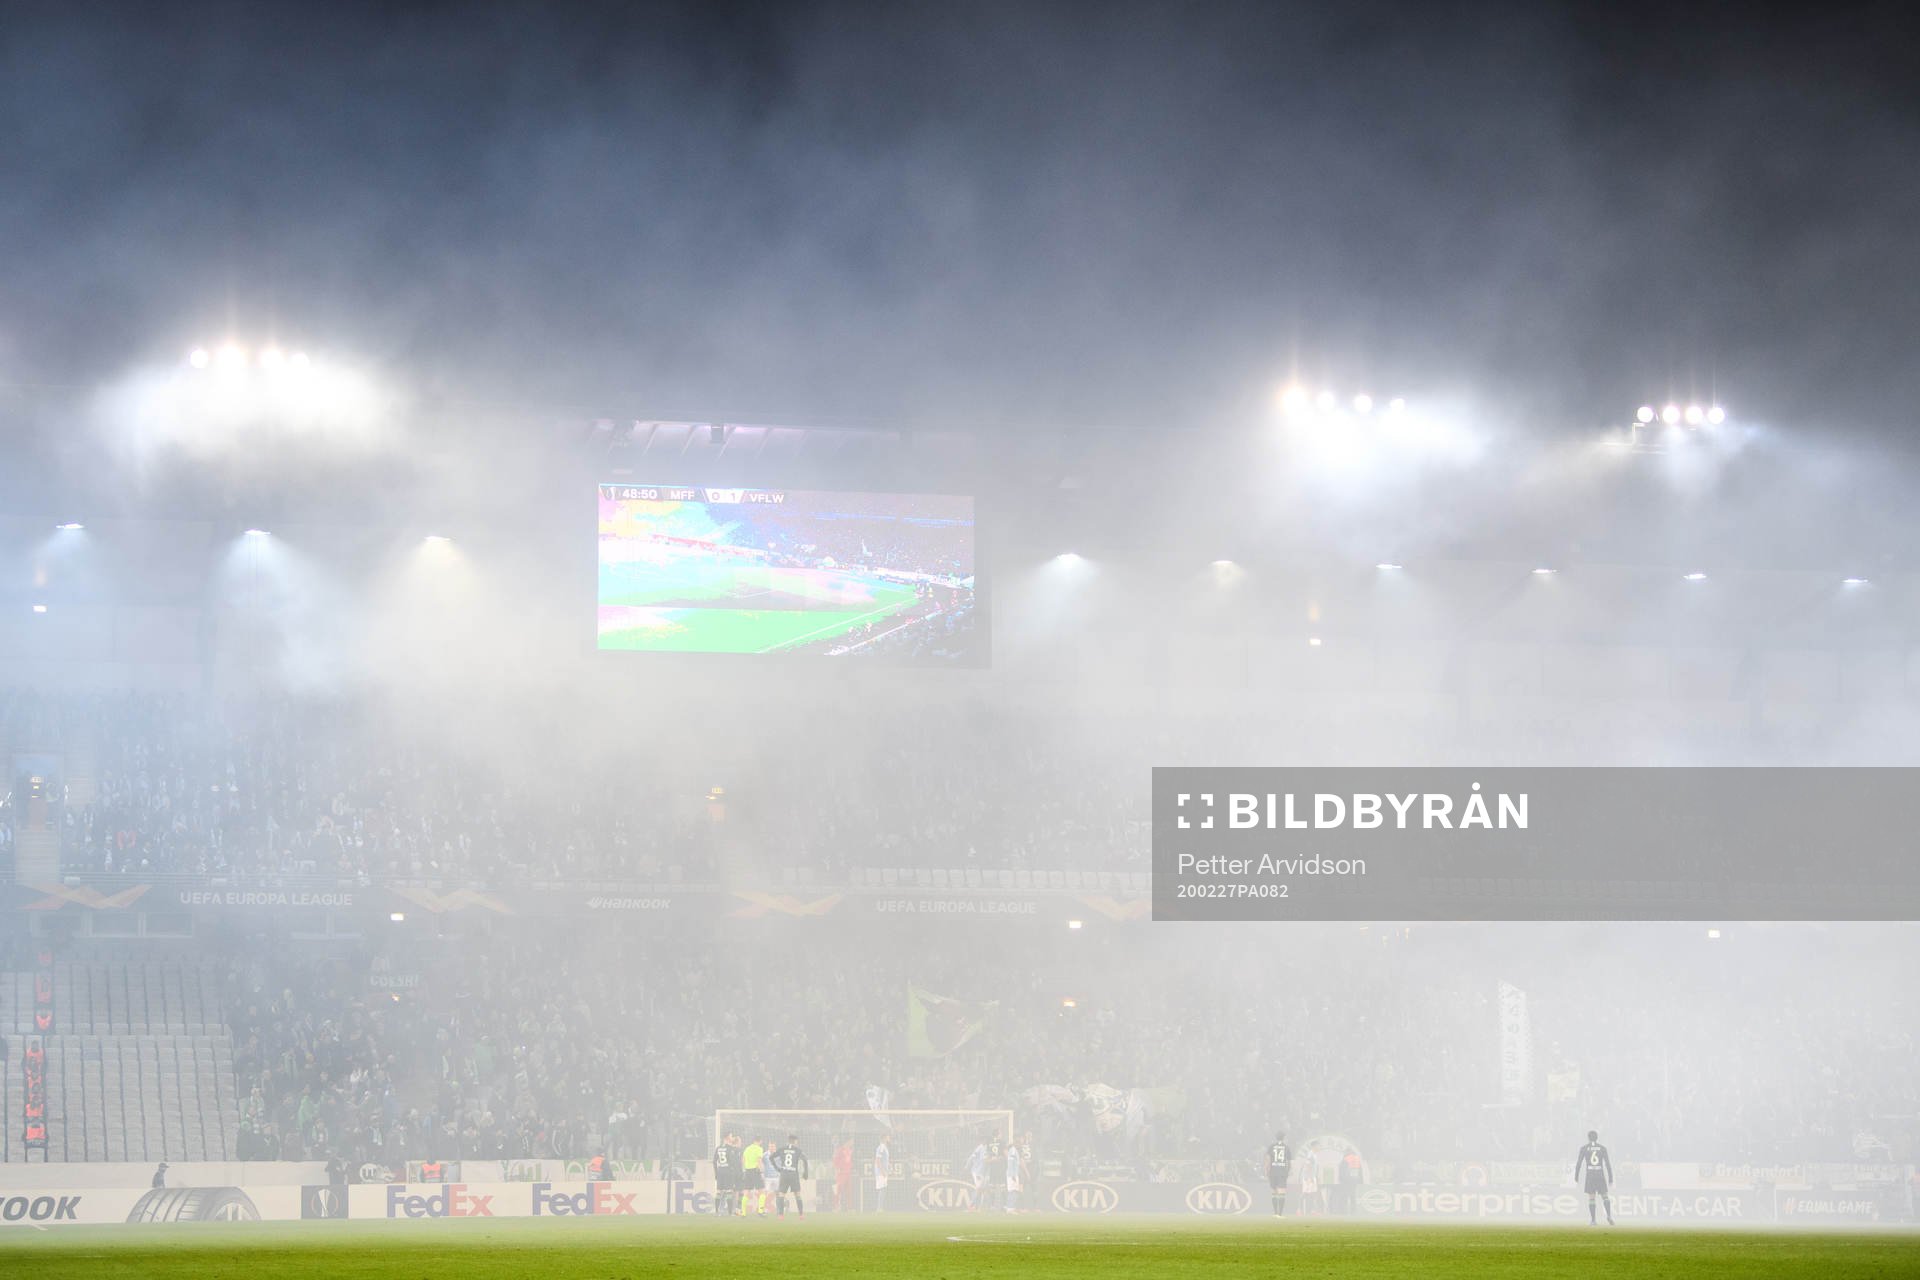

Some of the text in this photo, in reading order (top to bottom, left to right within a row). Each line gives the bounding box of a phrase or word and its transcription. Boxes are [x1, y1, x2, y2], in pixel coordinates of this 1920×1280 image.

[622, 489, 658, 500] 48:50
[670, 490, 696, 501] MFF
[749, 493, 785, 504] VFLW
[180, 892, 353, 907] UEFA EUROPA LEAGUE
[876, 899, 1037, 915] UEFA EUROPA LEAGUE
[784, 1153, 793, 1167] 8
[1272, 1150, 1285, 1162] 14
[1590, 1151, 1599, 1166] 6
[386, 1185, 494, 1217] FedEx
[532, 1182, 637, 1215] FedEx
[928, 1188, 973, 1208] KIA
[1063, 1189, 1109, 1209] KIA
[1197, 1190, 1243, 1209] KIA
[1360, 1187, 1580, 1218] enterprise
[0, 1196, 82, 1221] OOK
